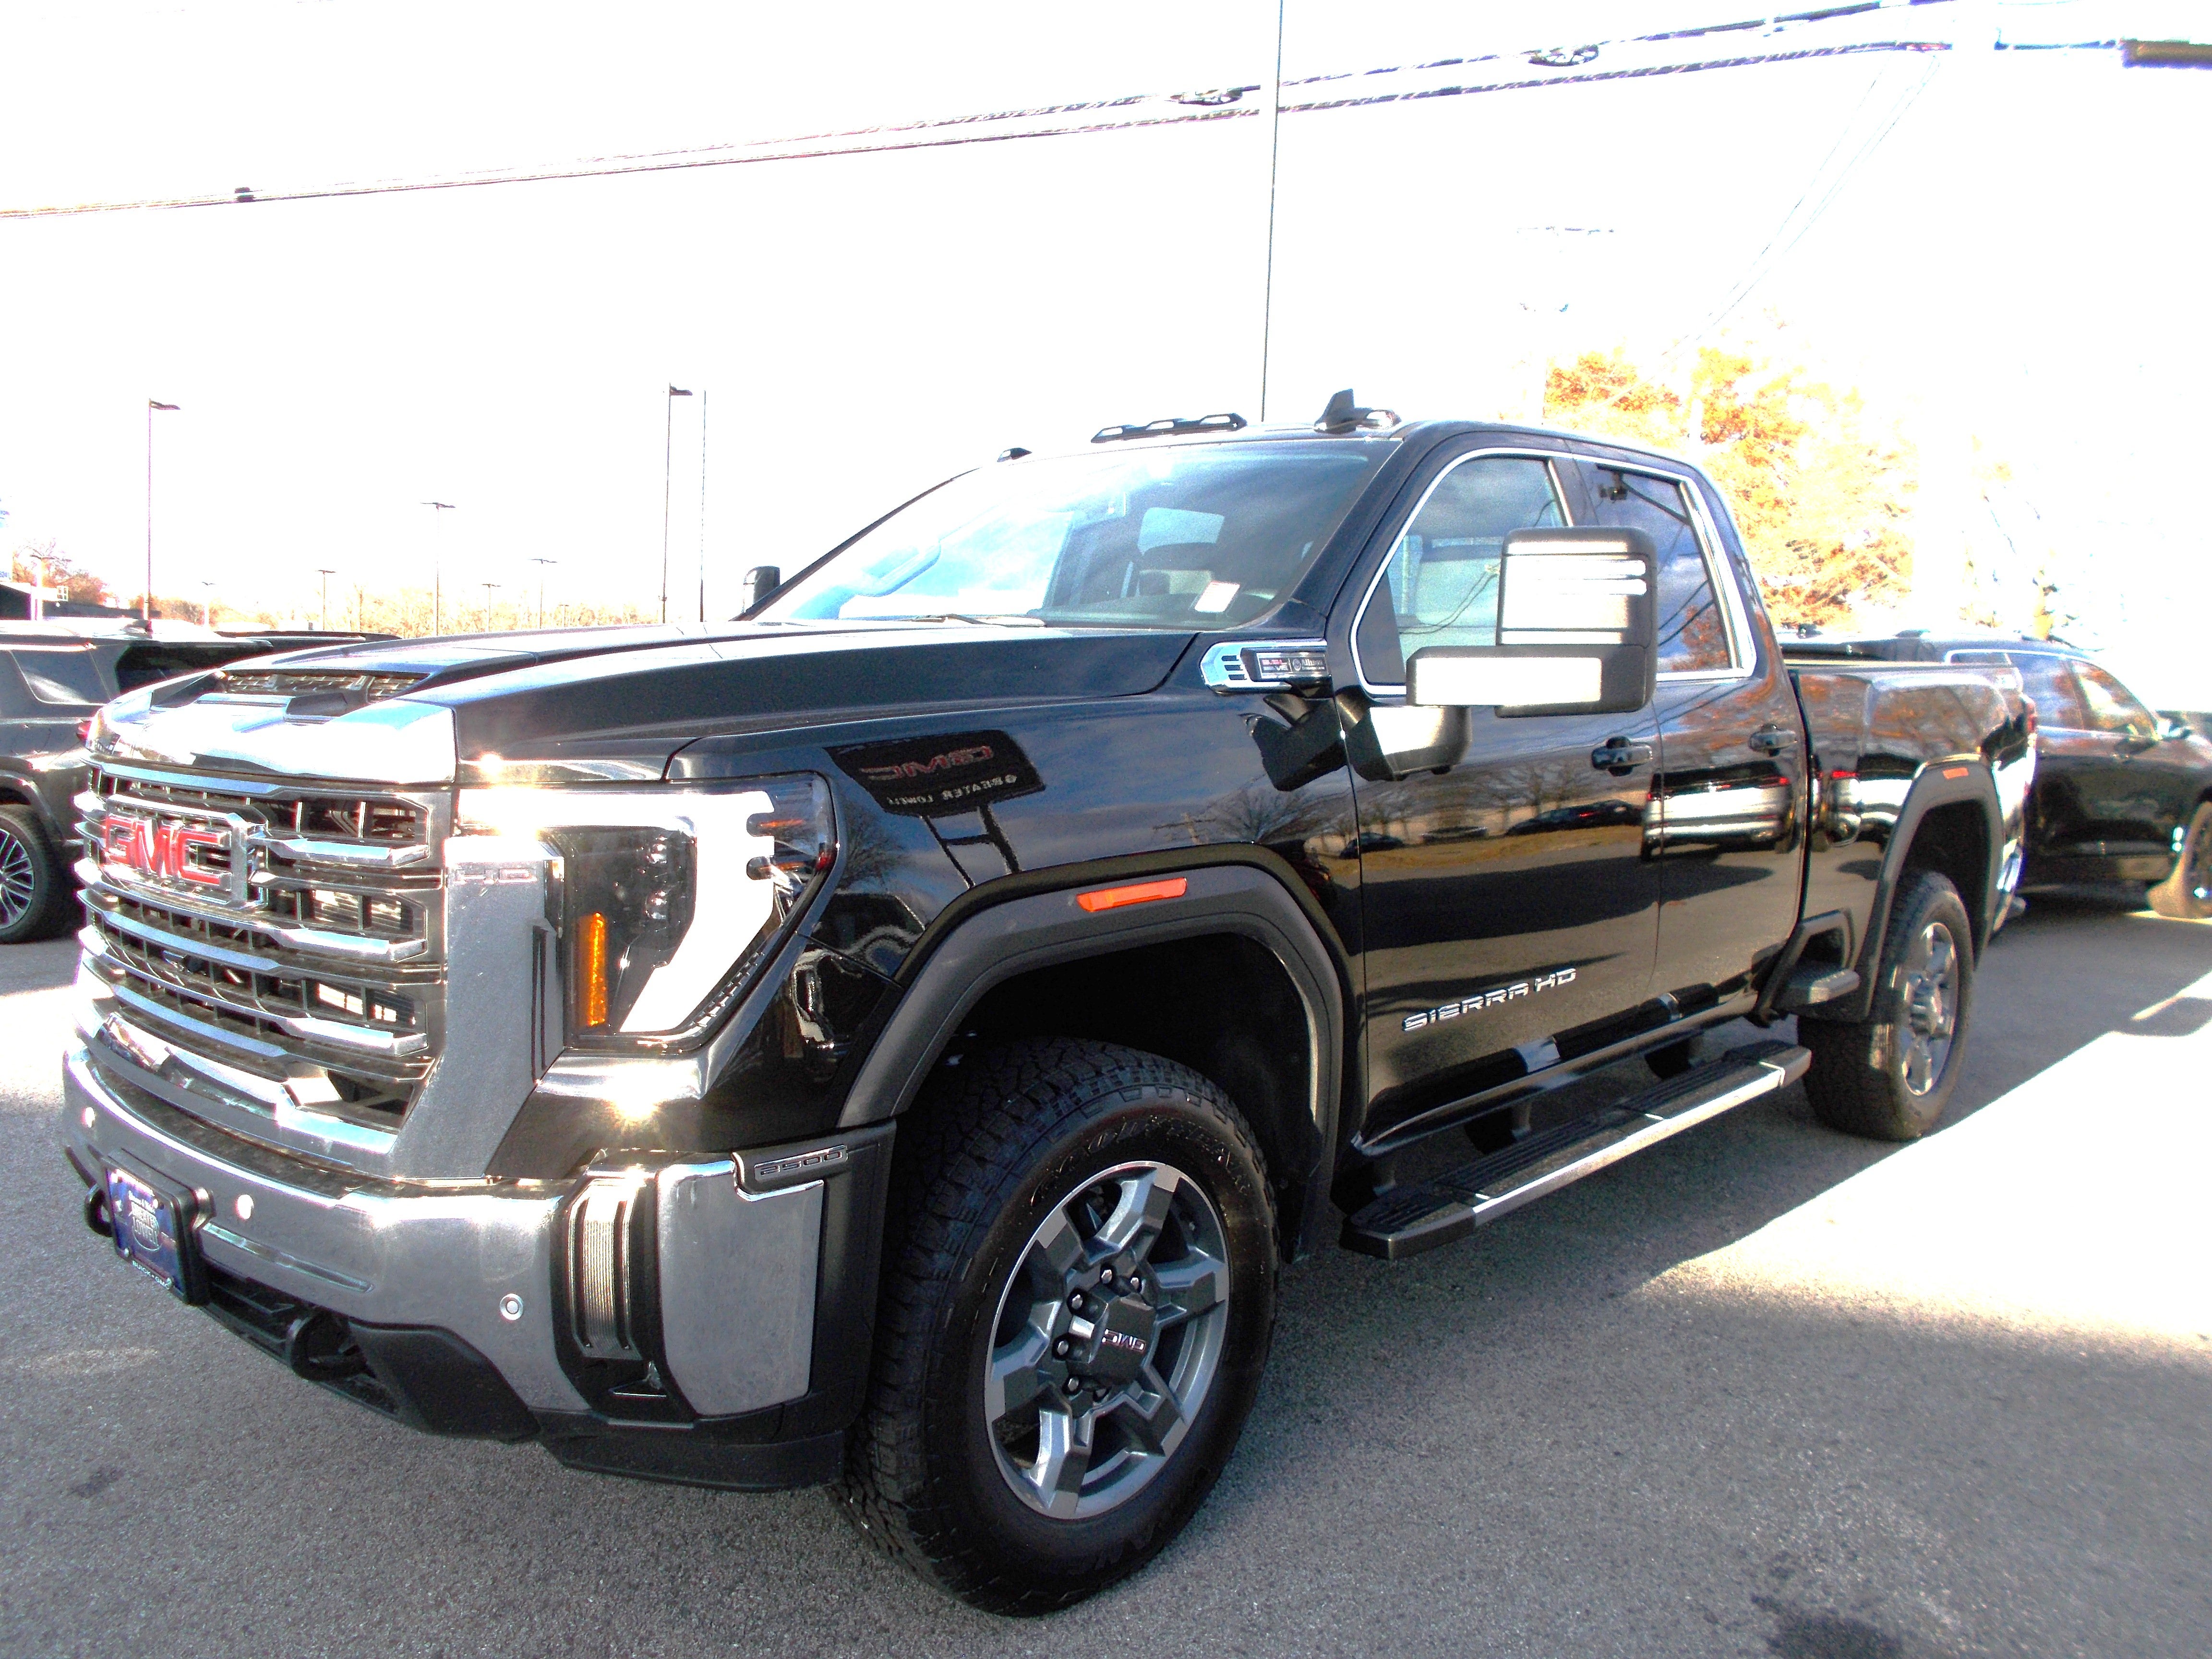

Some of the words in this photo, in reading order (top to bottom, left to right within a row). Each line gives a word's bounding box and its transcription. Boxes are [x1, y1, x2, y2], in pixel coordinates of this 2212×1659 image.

[105, 814, 233, 891] GMC
[1402, 982, 1529, 1032] SIERRA
[1534, 968, 1577, 992] HD
[760, 1151, 843, 1176] 2500
[132, 1260, 151, 1276] BUICK
[1102, 1328, 1146, 1354] GMC
